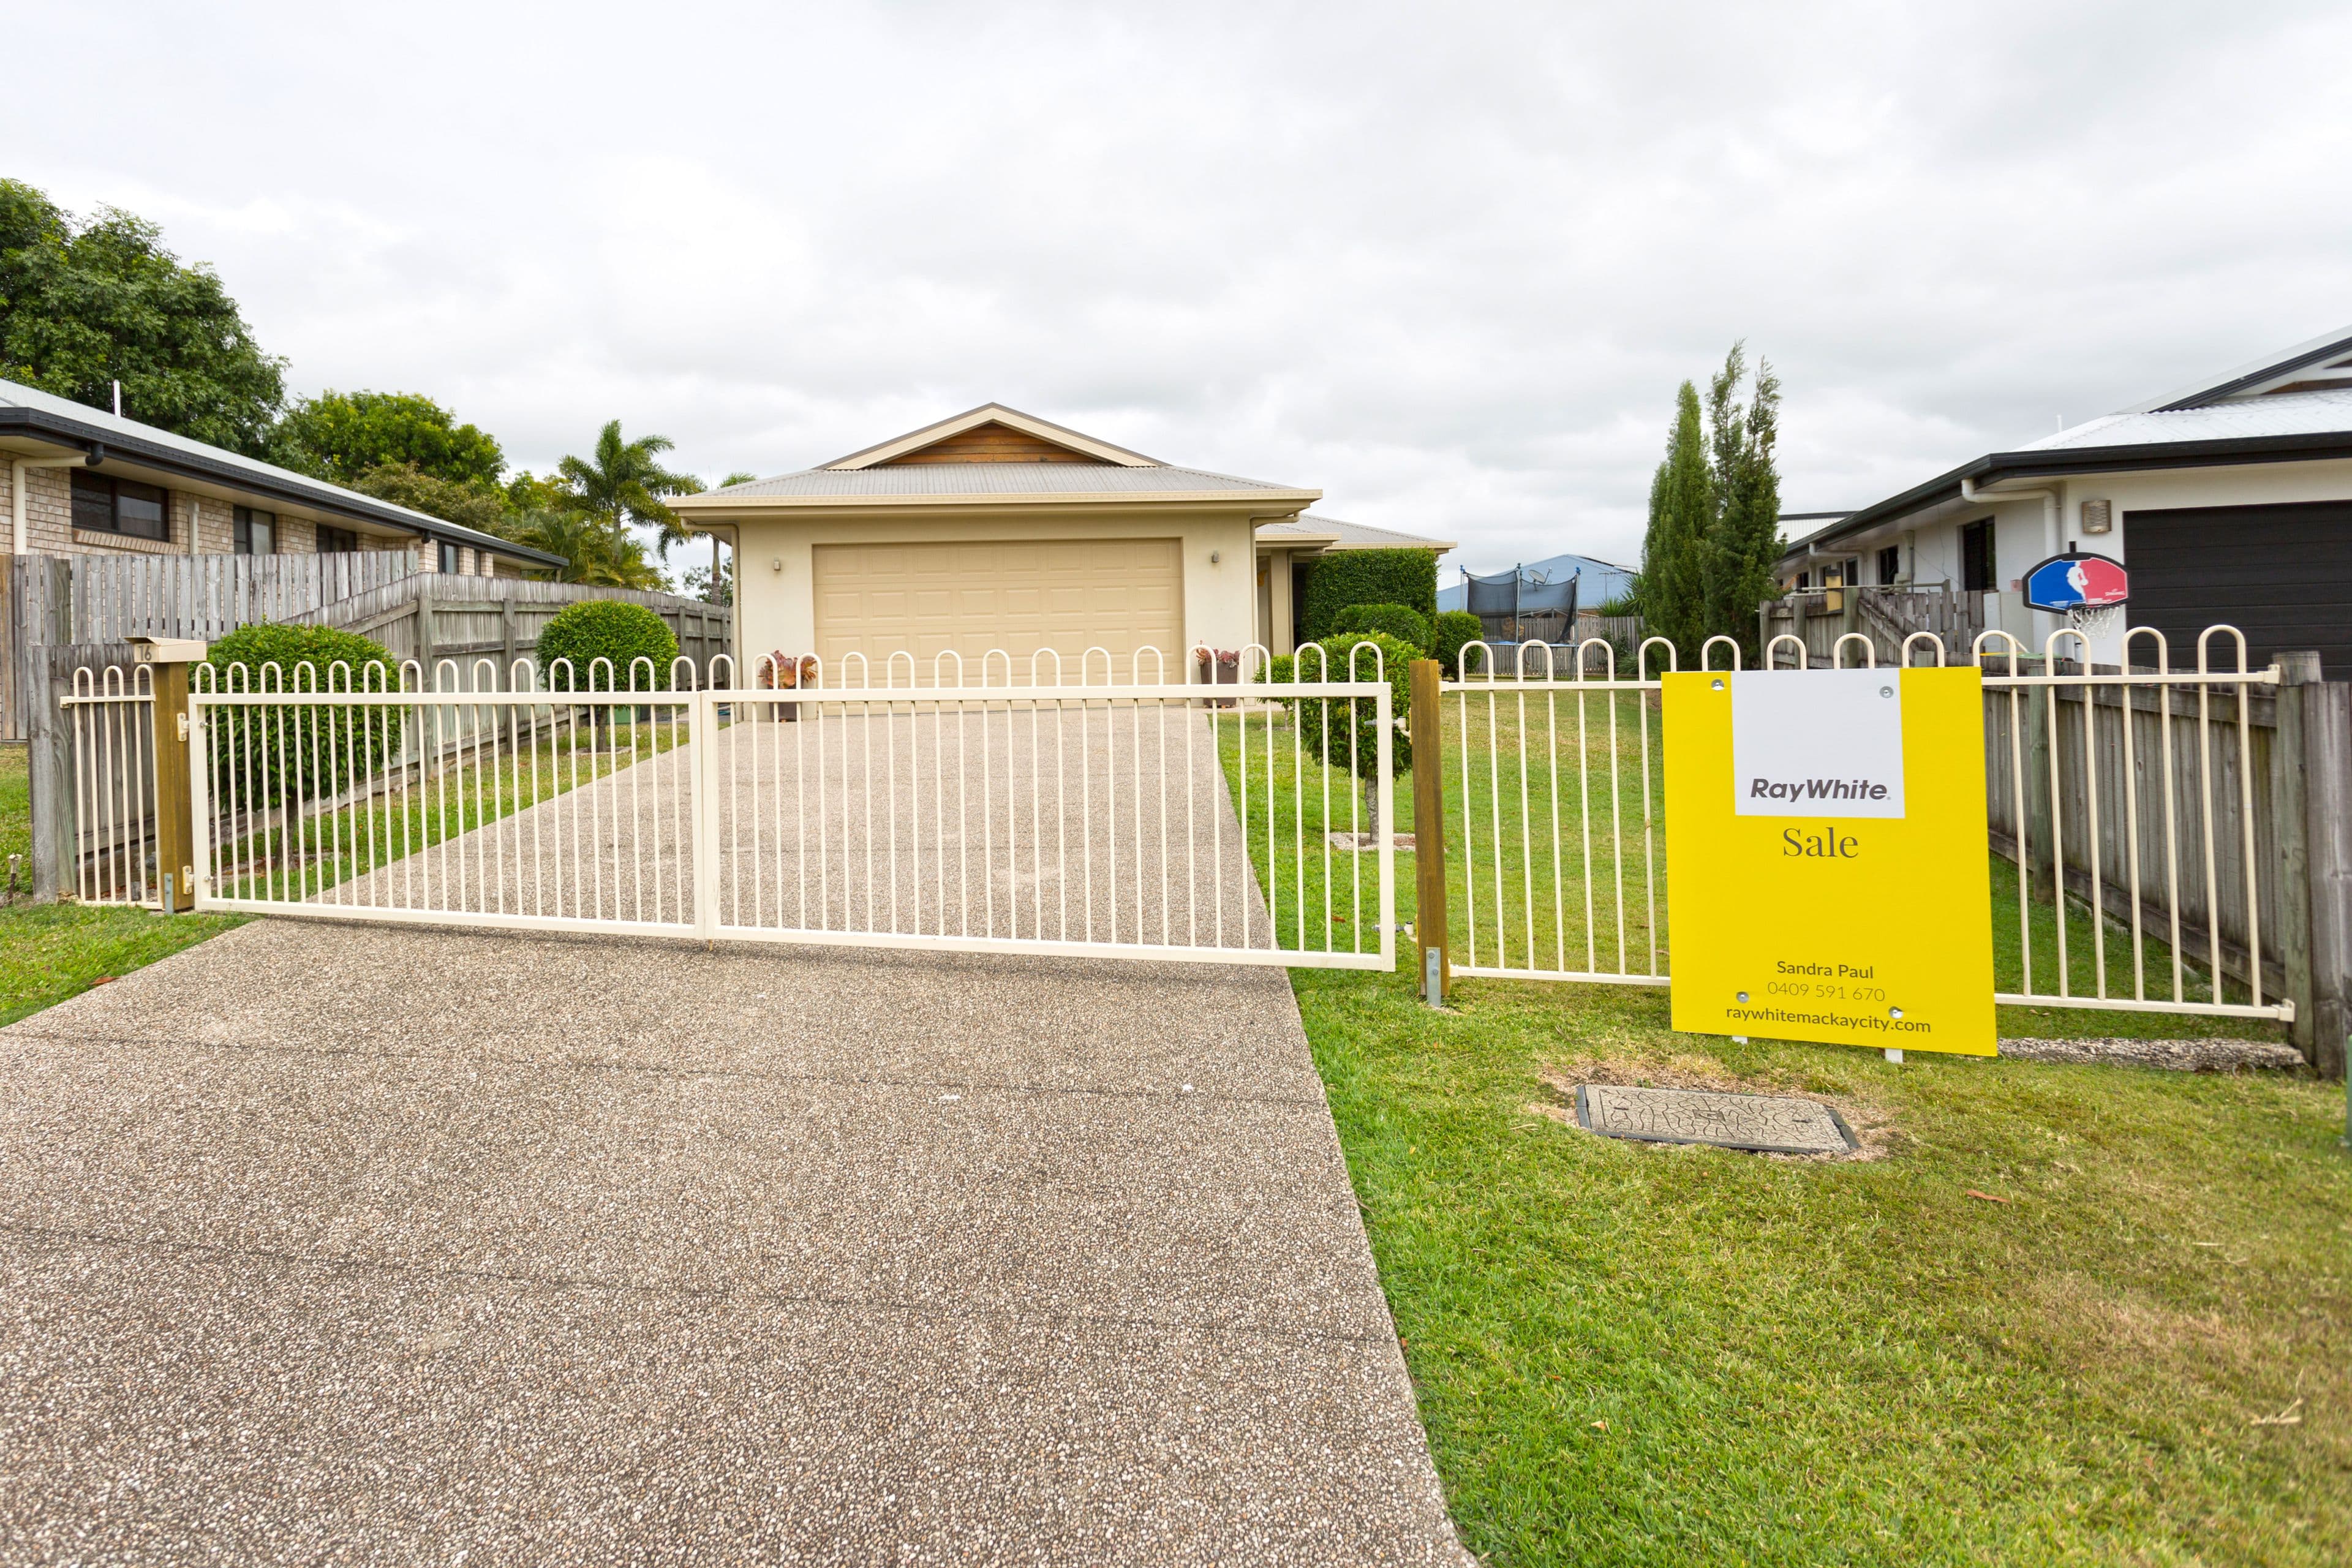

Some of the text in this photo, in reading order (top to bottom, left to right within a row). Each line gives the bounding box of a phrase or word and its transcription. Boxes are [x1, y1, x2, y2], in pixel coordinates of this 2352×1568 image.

[138, 645, 152, 661] 16
[1783, 827, 1859, 858] Sale
[1777, 961, 1874, 979] Sandra Paul
[1768, 981, 1885, 1001] 0409 591 670
[1727, 1008, 1931, 1033] raywhitemackaycity.com
